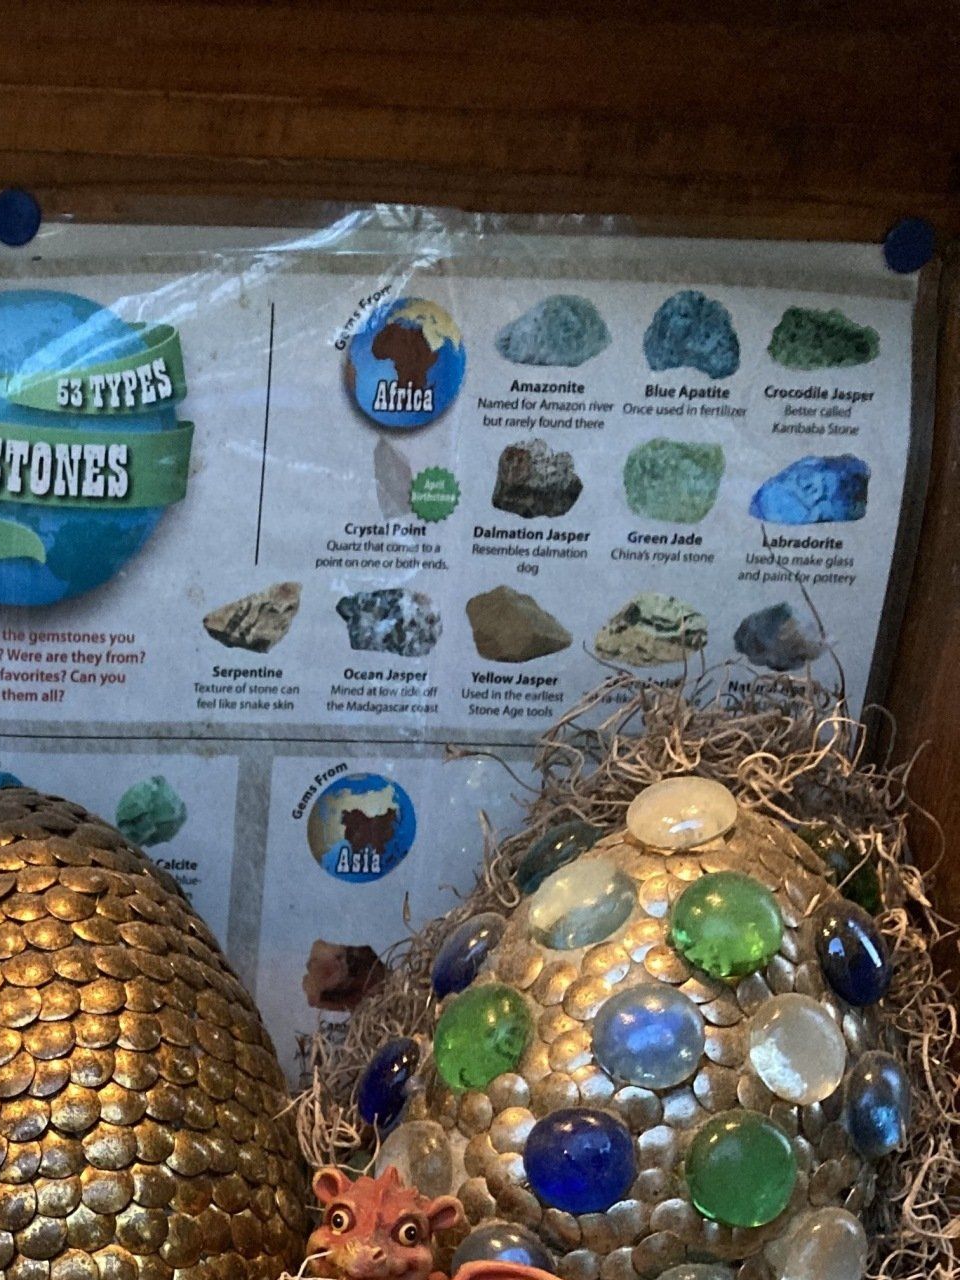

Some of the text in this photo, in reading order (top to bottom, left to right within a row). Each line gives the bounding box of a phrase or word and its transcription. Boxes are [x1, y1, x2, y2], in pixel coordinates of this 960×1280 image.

[57, 358, 172, 408] 53 TYPES
[511, 380, 584, 394] Amazonite
[374, 381, 433, 412] Africa
[646, 384, 730, 400] Blue Apatite
[764, 386, 874, 402] Crocodile Jasper
[478, 398, 613, 412] Named for Amazon river
[623, 404, 747, 417] Once used in fertilizer
[483, 416, 604, 430] but rarely found there
[345, 523, 426, 537] Crystal Point
[474, 527, 590, 543] Dalmation Jasper
[628, 532, 702, 546] Green Jade
[762, 536, 843, 550] Labradorite
[472, 544, 587, 558] Resembles dalmation
[610, 550, 714, 563] China's royal stone
[517, 563, 539, 576] dog
[2, 629, 25, 642] the
[29, 631, 105, 645] gemstones
[110, 632, 135, 645] you
[7, 650, 42, 662] Were
[46, 652, 67, 662] are
[72, 650, 102, 666] they
[106, 651, 145, 664] from?
[0, 668, 66, 682] favorites?
[70, 670, 96, 683] Can
[100, 674, 126, 686] you
[212, 666, 282, 680] Serpentine
[343, 669, 427, 682] Ocean Jasper
[472, 672, 558, 688] Yellow Jasper
[2, 690, 38, 702] them
[42, 690, 64, 702] all?
[194, 683, 299, 695] Texture of stone can
[461, 688, 563, 703] Used in the earliest
[197, 698, 294, 710] feel like snake skin
[469, 704, 553, 719] Stone Age tools
[292, 762, 348, 820] Gems From
[337, 847, 381, 873] Asia
